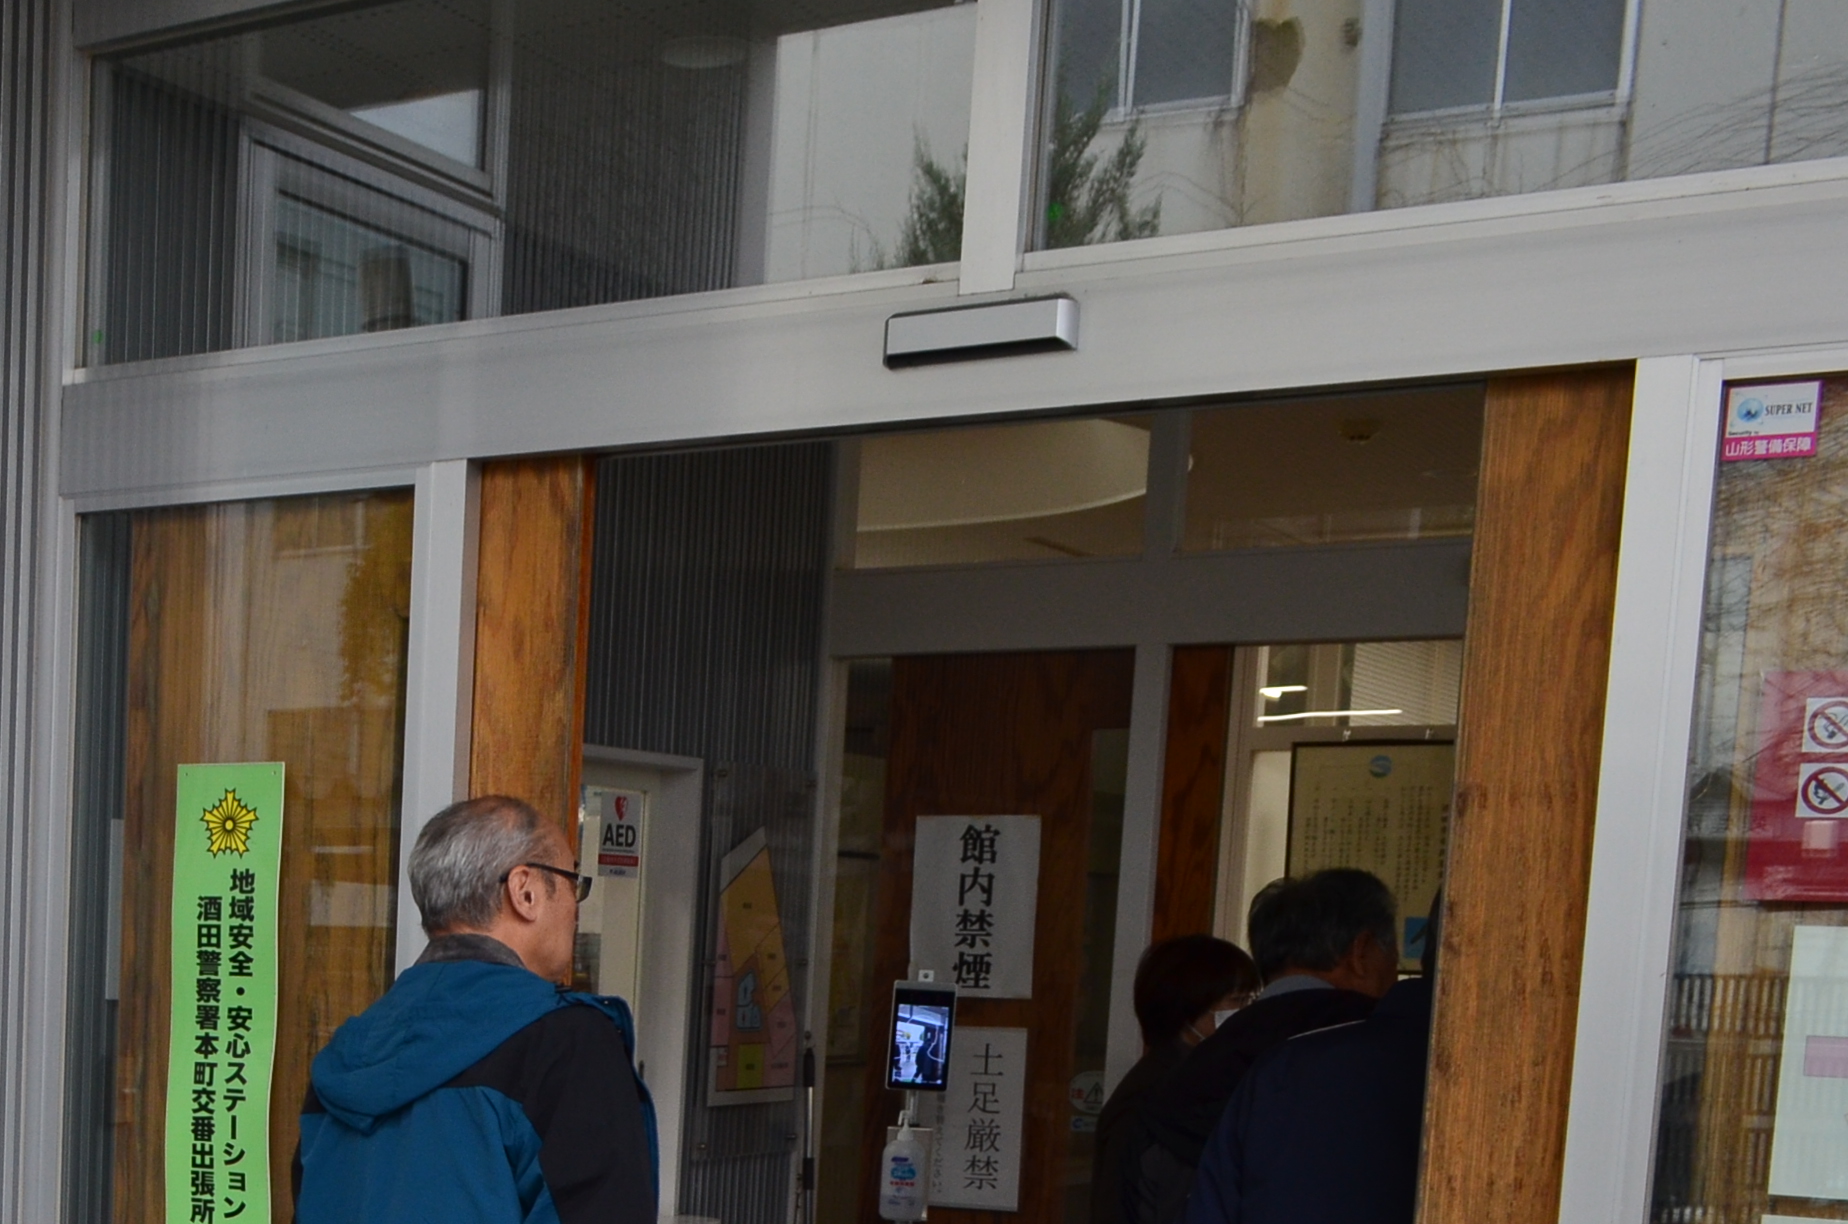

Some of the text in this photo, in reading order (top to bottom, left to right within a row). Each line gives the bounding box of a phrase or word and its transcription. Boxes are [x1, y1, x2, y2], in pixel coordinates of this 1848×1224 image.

[1725, 436, 1812, 456] 山形警備保障
[1764, 402, 1814, 416] SUPER NET
[602, 823, 637, 848] AED
[952, 823, 1000, 990] 館内禁煙
[222, 868, 255, 1219] 地域安全・安心ステーション
[963, 1042, 1004, 1191] 土足厳禁
